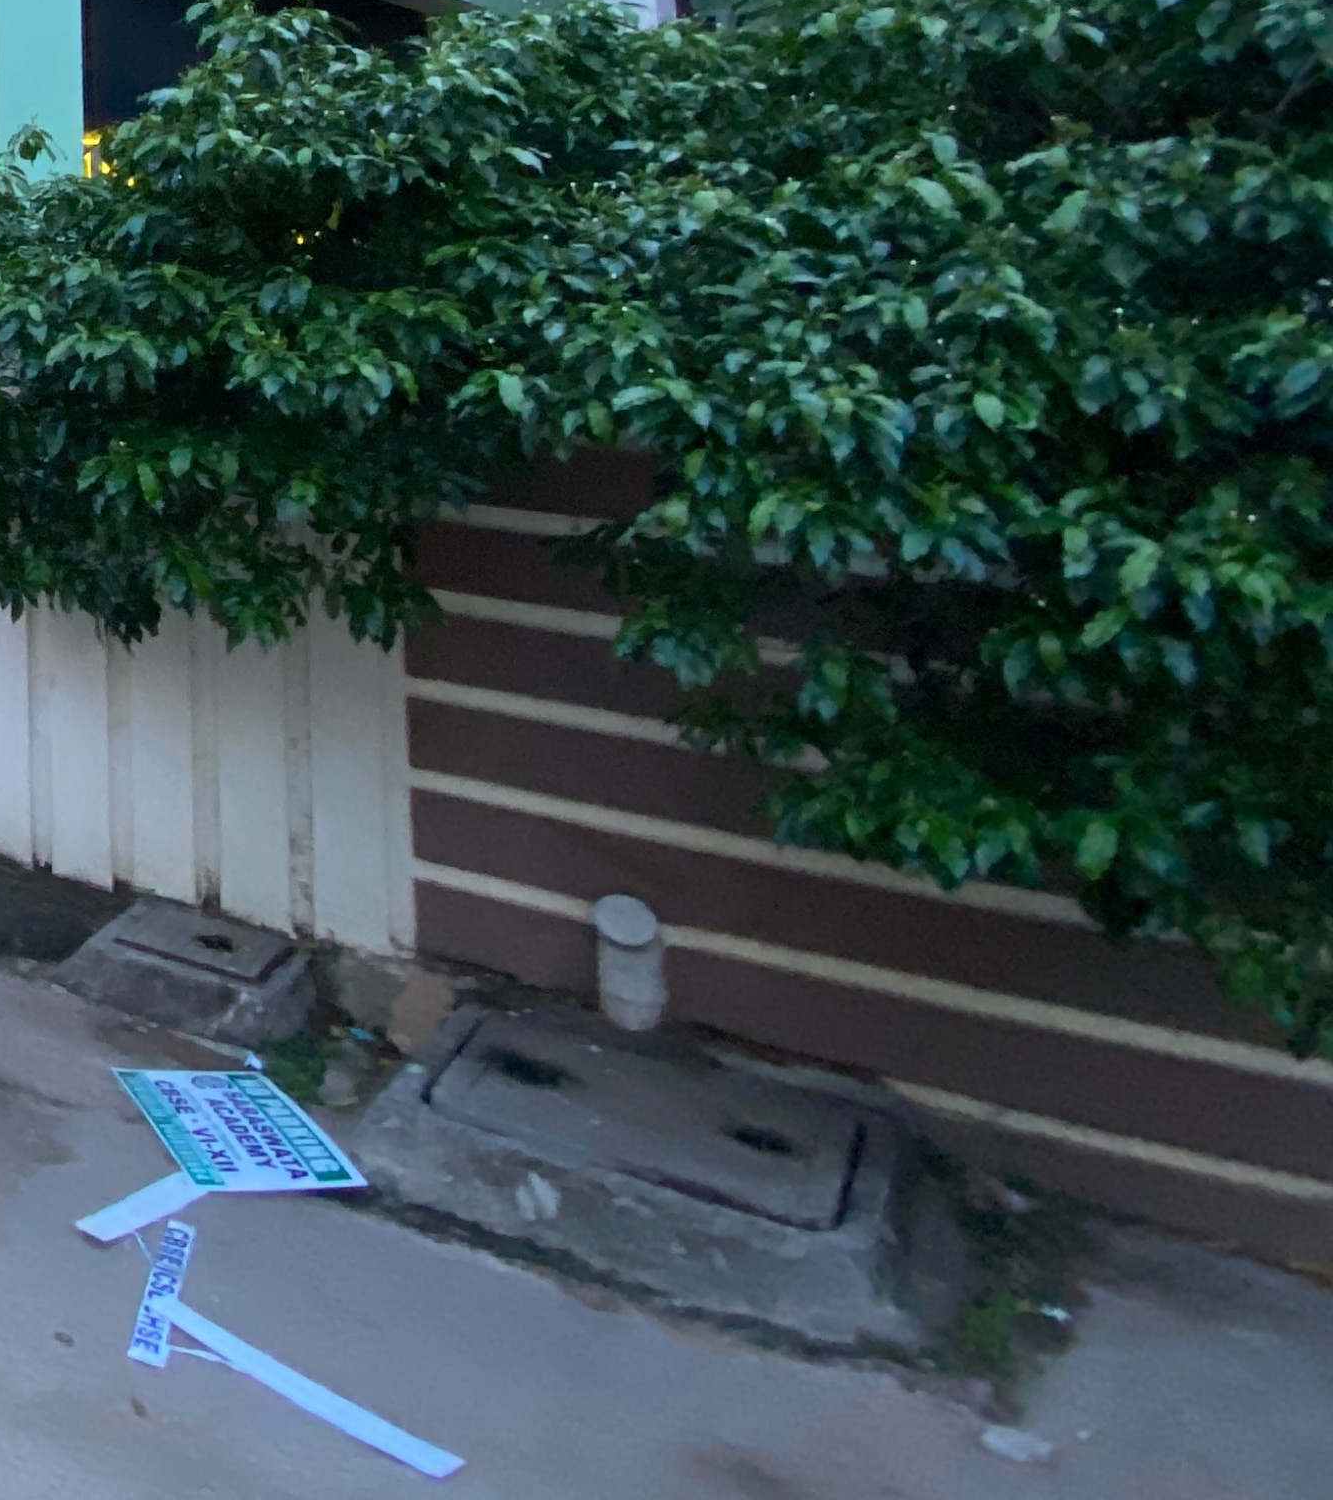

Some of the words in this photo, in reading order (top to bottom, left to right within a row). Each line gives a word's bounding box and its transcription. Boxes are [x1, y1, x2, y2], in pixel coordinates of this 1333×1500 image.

[154, 1080, 195, 1114] CBSE
[204, 1098, 278, 1169] ACADEMY
[222, 1091, 309, 1180] SARASWATA
[254, 1099, 342, 1173] PARKING
[133, 1304, 166, 1355] HSE
